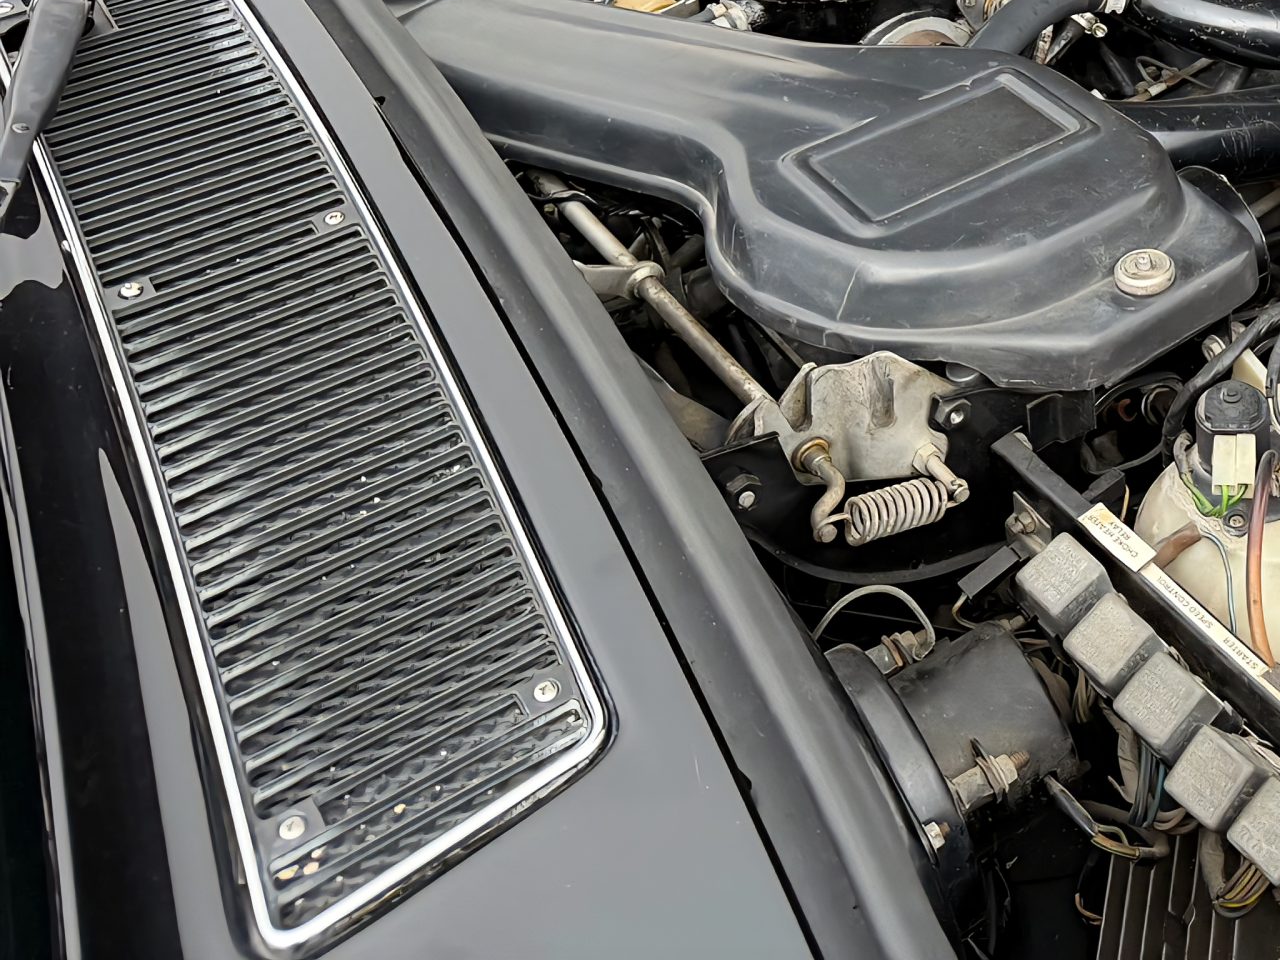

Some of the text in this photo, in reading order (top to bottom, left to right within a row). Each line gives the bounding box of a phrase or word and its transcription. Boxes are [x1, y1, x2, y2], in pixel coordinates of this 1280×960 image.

[1087, 514, 1139, 558] CHOKE HEATER
[1109, 521, 1131, 541] RELAY
[1223, 636, 1259, 670] STARTER
